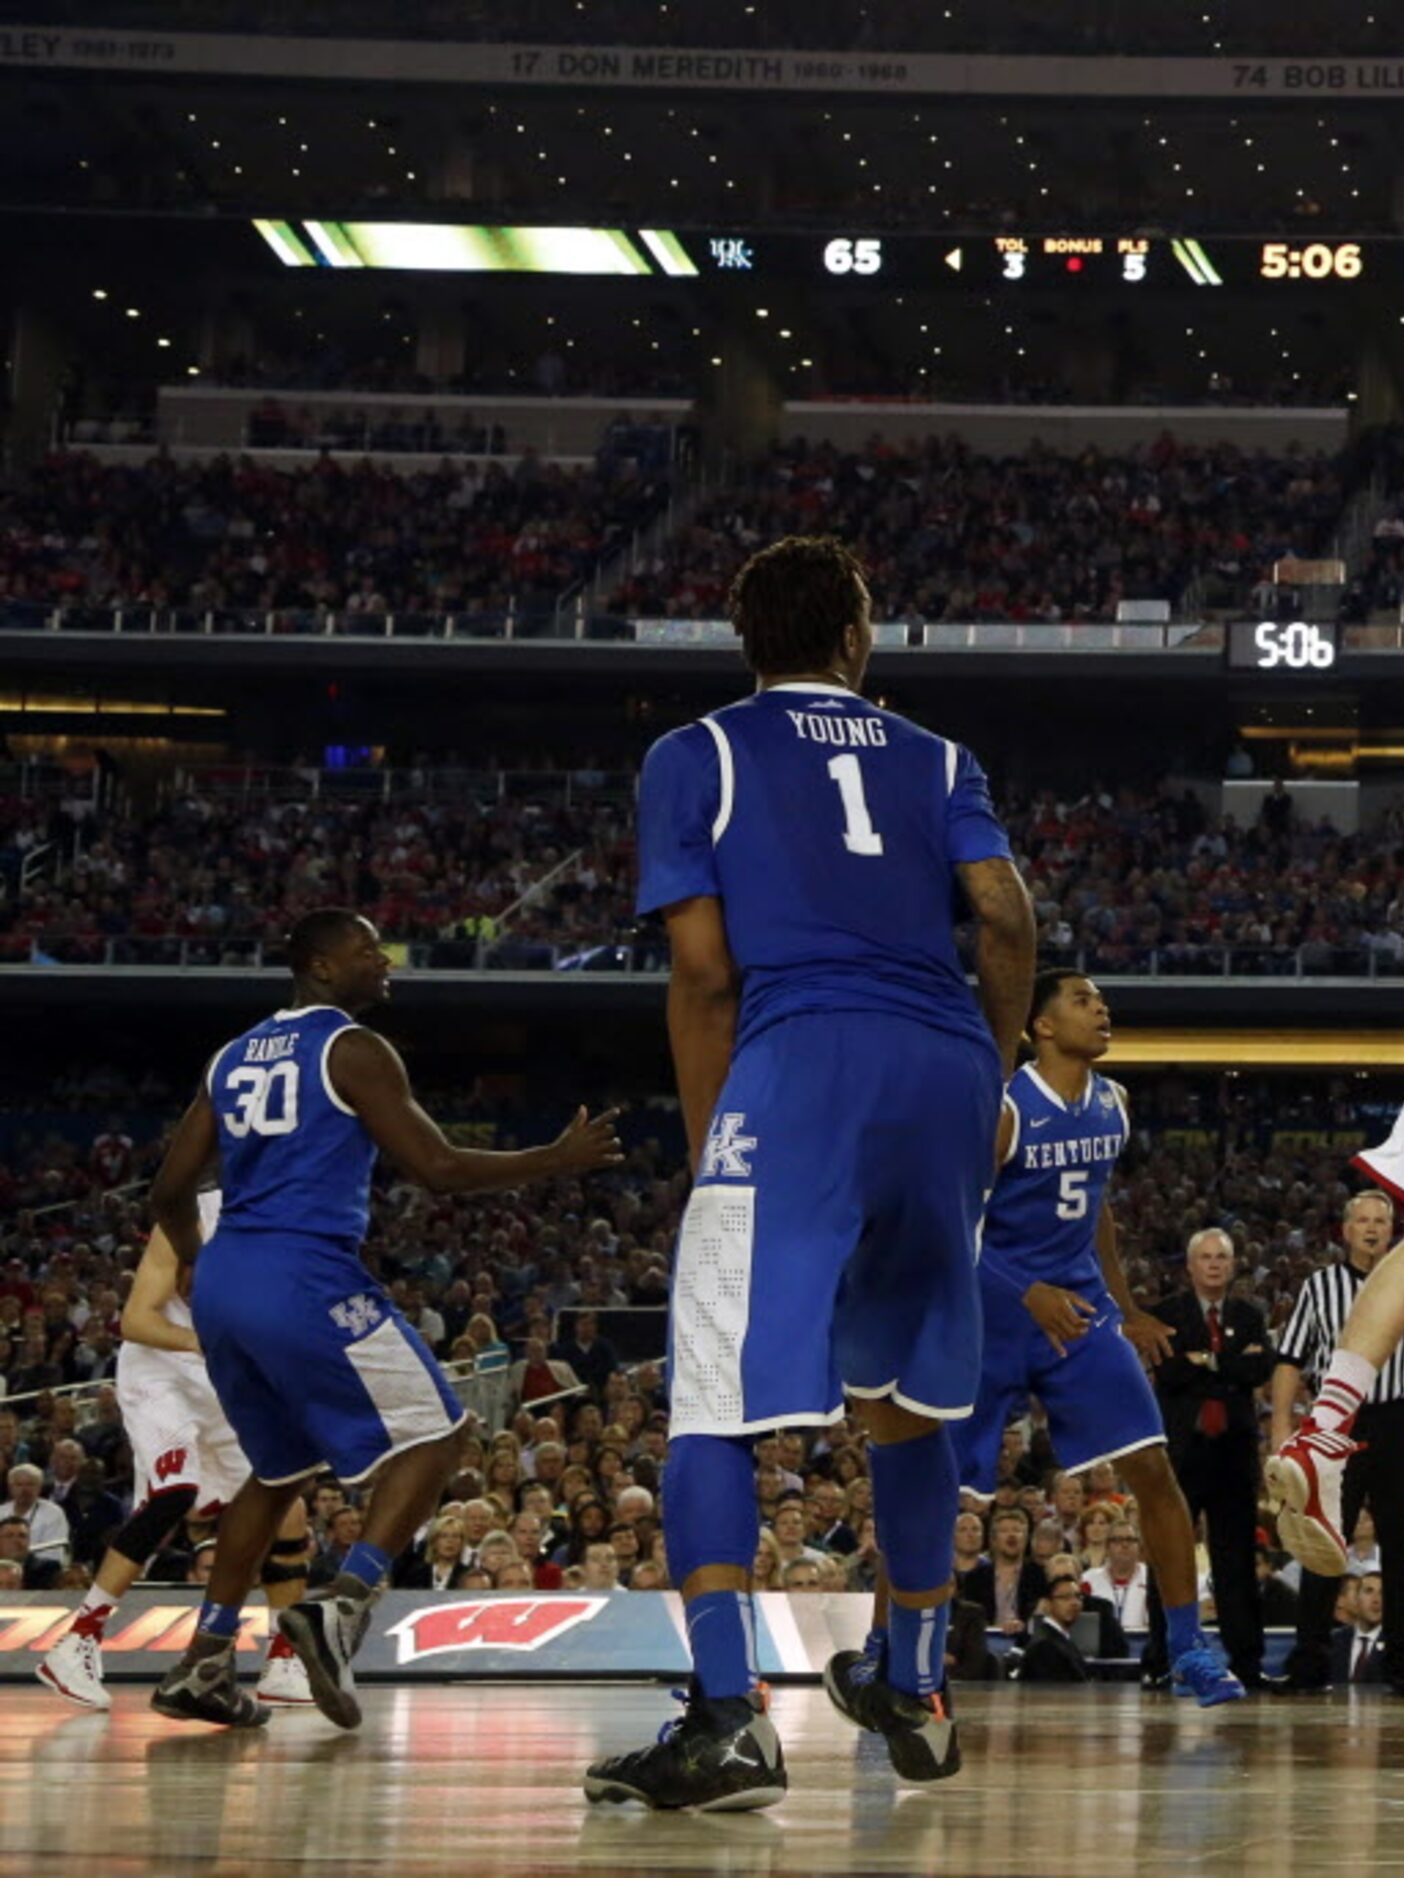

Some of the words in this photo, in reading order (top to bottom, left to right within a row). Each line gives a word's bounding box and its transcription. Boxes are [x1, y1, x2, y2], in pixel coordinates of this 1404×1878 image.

[511, 53, 541, 75] 17
[558, 54, 620, 77] DON
[632, 56, 783, 81] MEREDITH
[1232, 65, 1269, 88] 74
[1283, 65, 1347, 88] BOB
[823, 239, 881, 274] 65
[996, 238, 1028, 253] TOL
[1044, 238, 1103, 253] BONUS
[1260, 243, 1362, 279] 5:06
[1003, 254, 1025, 280] 3
[1123, 255, 1146, 281] 5
[1255, 621, 1335, 668] 5:06
[785, 709, 888, 747] YOUNG
[827, 753, 884, 856] 1
[243, 1033, 300, 1062] RANDLE
[224, 1060, 300, 1139] 30
[1024, 1133, 1123, 1169] KENTUCKY
[1055, 1170, 1089, 1221] 5
